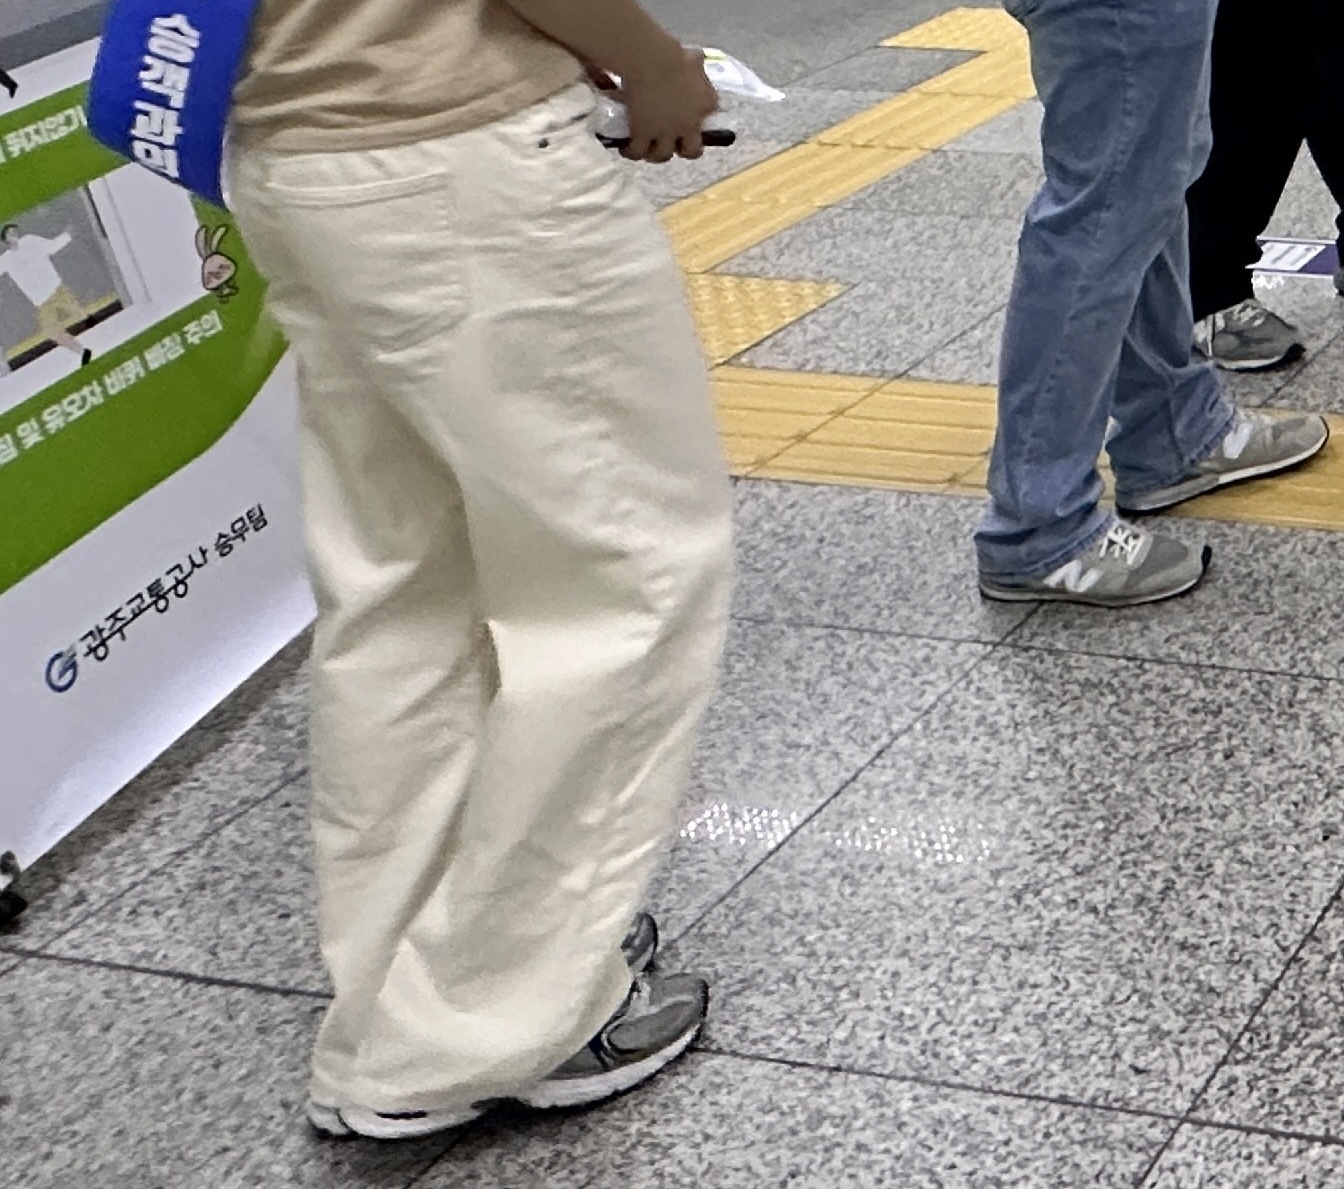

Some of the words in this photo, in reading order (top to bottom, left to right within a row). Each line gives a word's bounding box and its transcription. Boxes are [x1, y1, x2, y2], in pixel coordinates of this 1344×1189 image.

[182, 310, 223, 344] 주의
[79, 545, 208, 661] 광주교통공사
[214, 503, 268, 557] 승무팀
